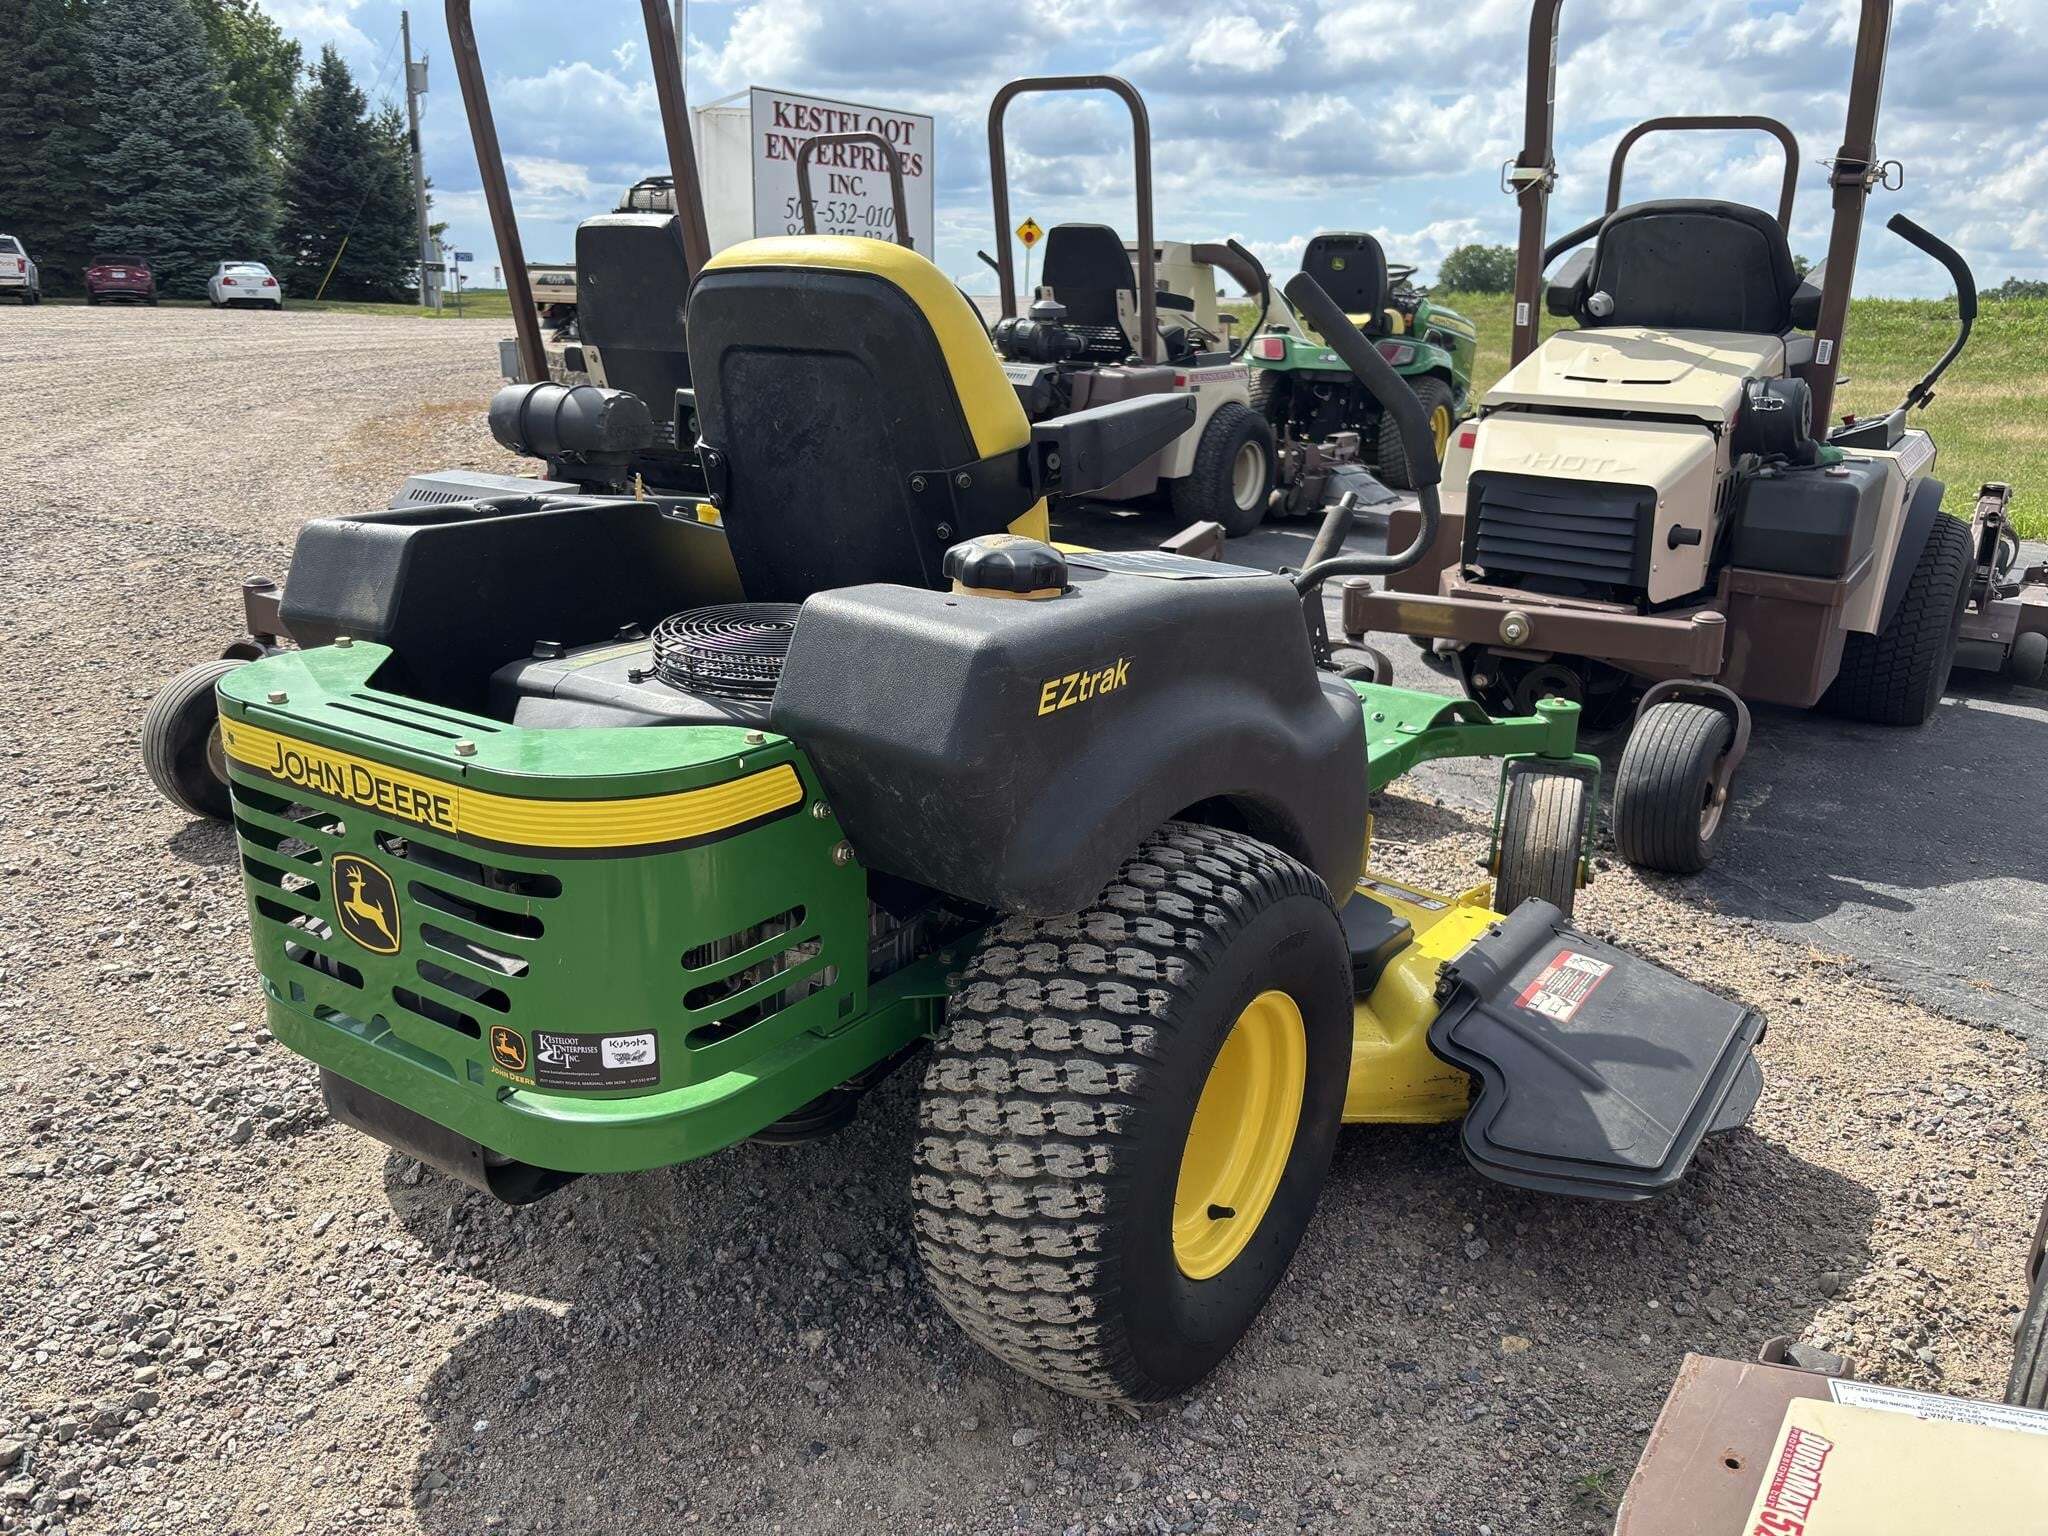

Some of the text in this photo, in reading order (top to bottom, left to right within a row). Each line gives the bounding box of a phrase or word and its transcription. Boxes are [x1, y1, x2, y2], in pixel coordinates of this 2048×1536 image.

[772, 101, 915, 146] KESTELOOT
[765, 133, 923, 178] ENERPRIES
[1038, 658, 1131, 716] EZtrak
[270, 742, 454, 828] JOHN DEERE
[539, 1034, 579, 1050] KESTELOOT
[552, 1045, 598, 1060] ENTERPRISES
[609, 1038, 648, 1048] Kubota
[491, 1065, 509, 1078] JOHN
[1765, 1427, 1801, 1508] PROFESSIONAL CUT
[1774, 1429, 1834, 1521] DURAMAX
